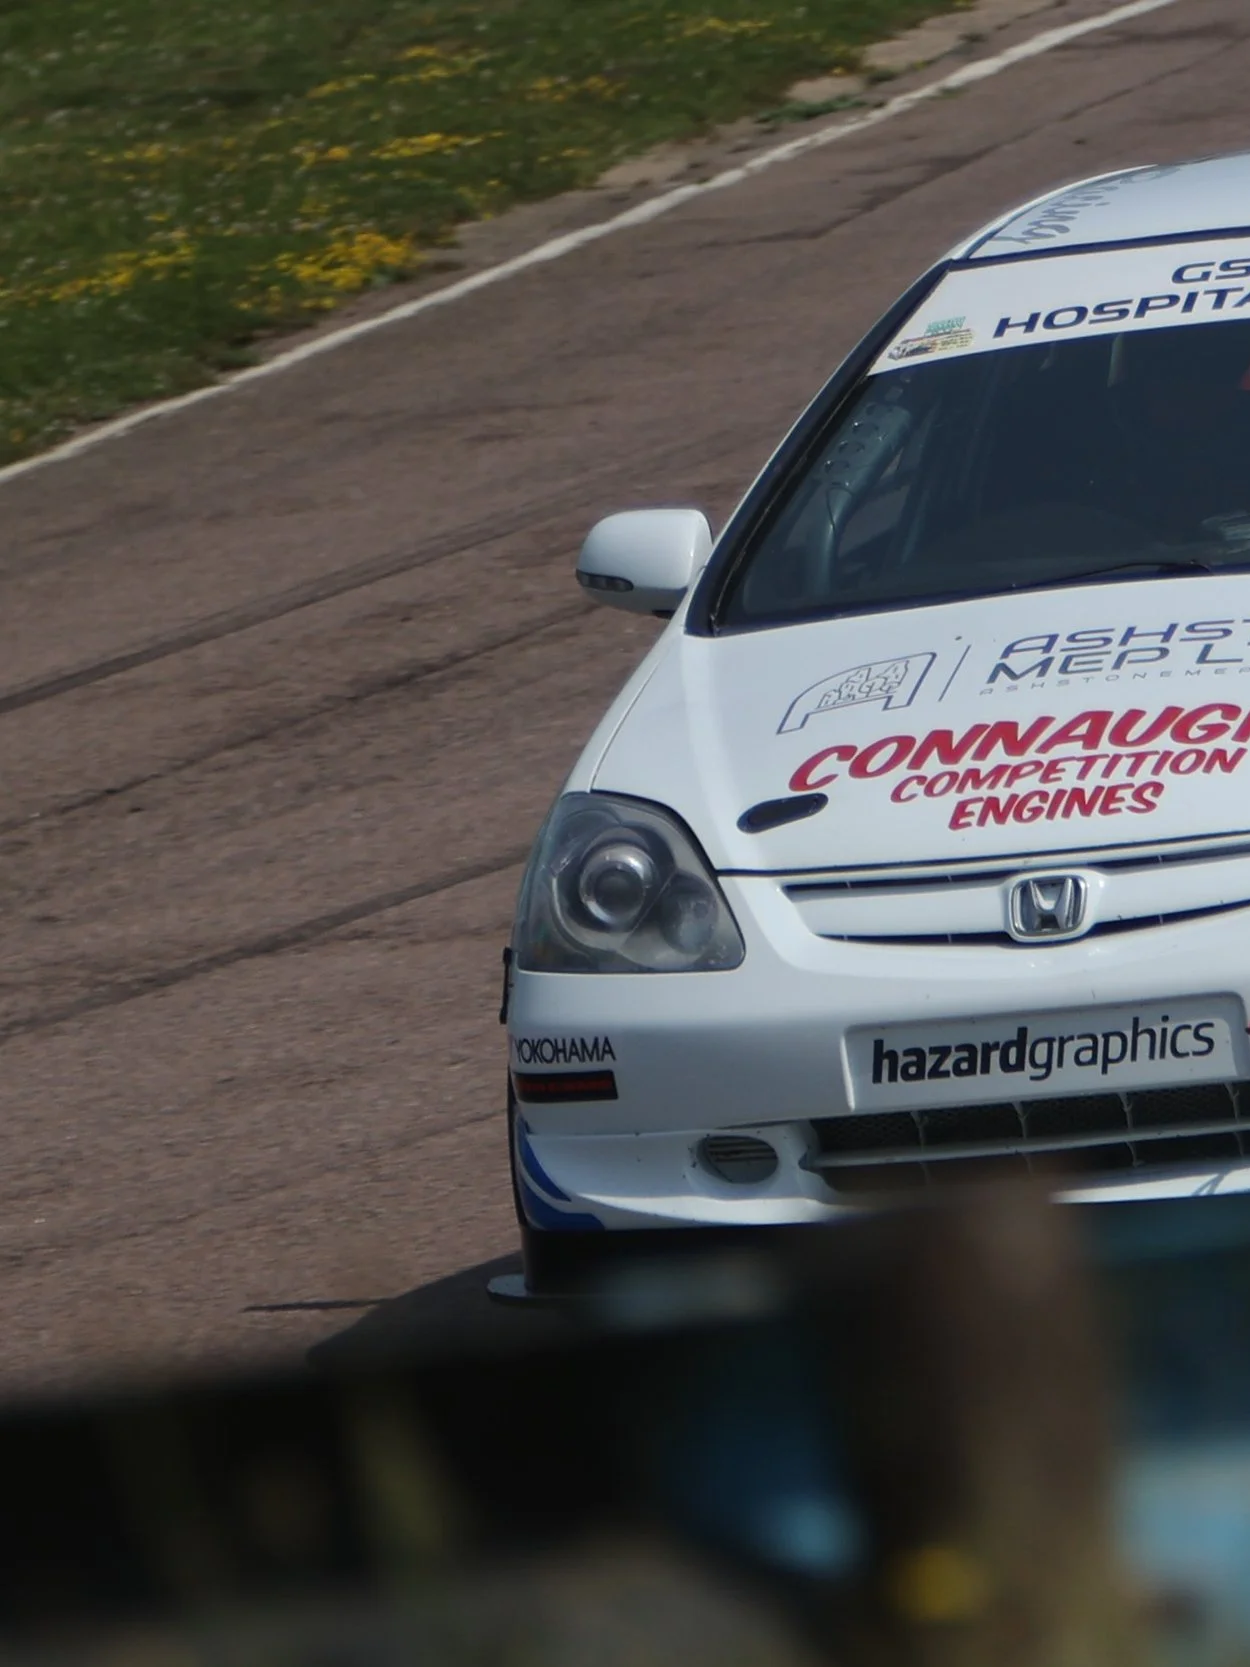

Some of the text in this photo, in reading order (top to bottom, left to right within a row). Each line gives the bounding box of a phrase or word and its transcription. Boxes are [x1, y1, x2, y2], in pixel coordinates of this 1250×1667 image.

[985, 646, 1170, 685] MEP
[890, 747, 1247, 805] COMPETITION
[948, 781, 1165, 831] ENGINES
[514, 1035, 618, 1064] YOKOHAMA
[872, 1014, 1216, 1084] hazardgraphics
